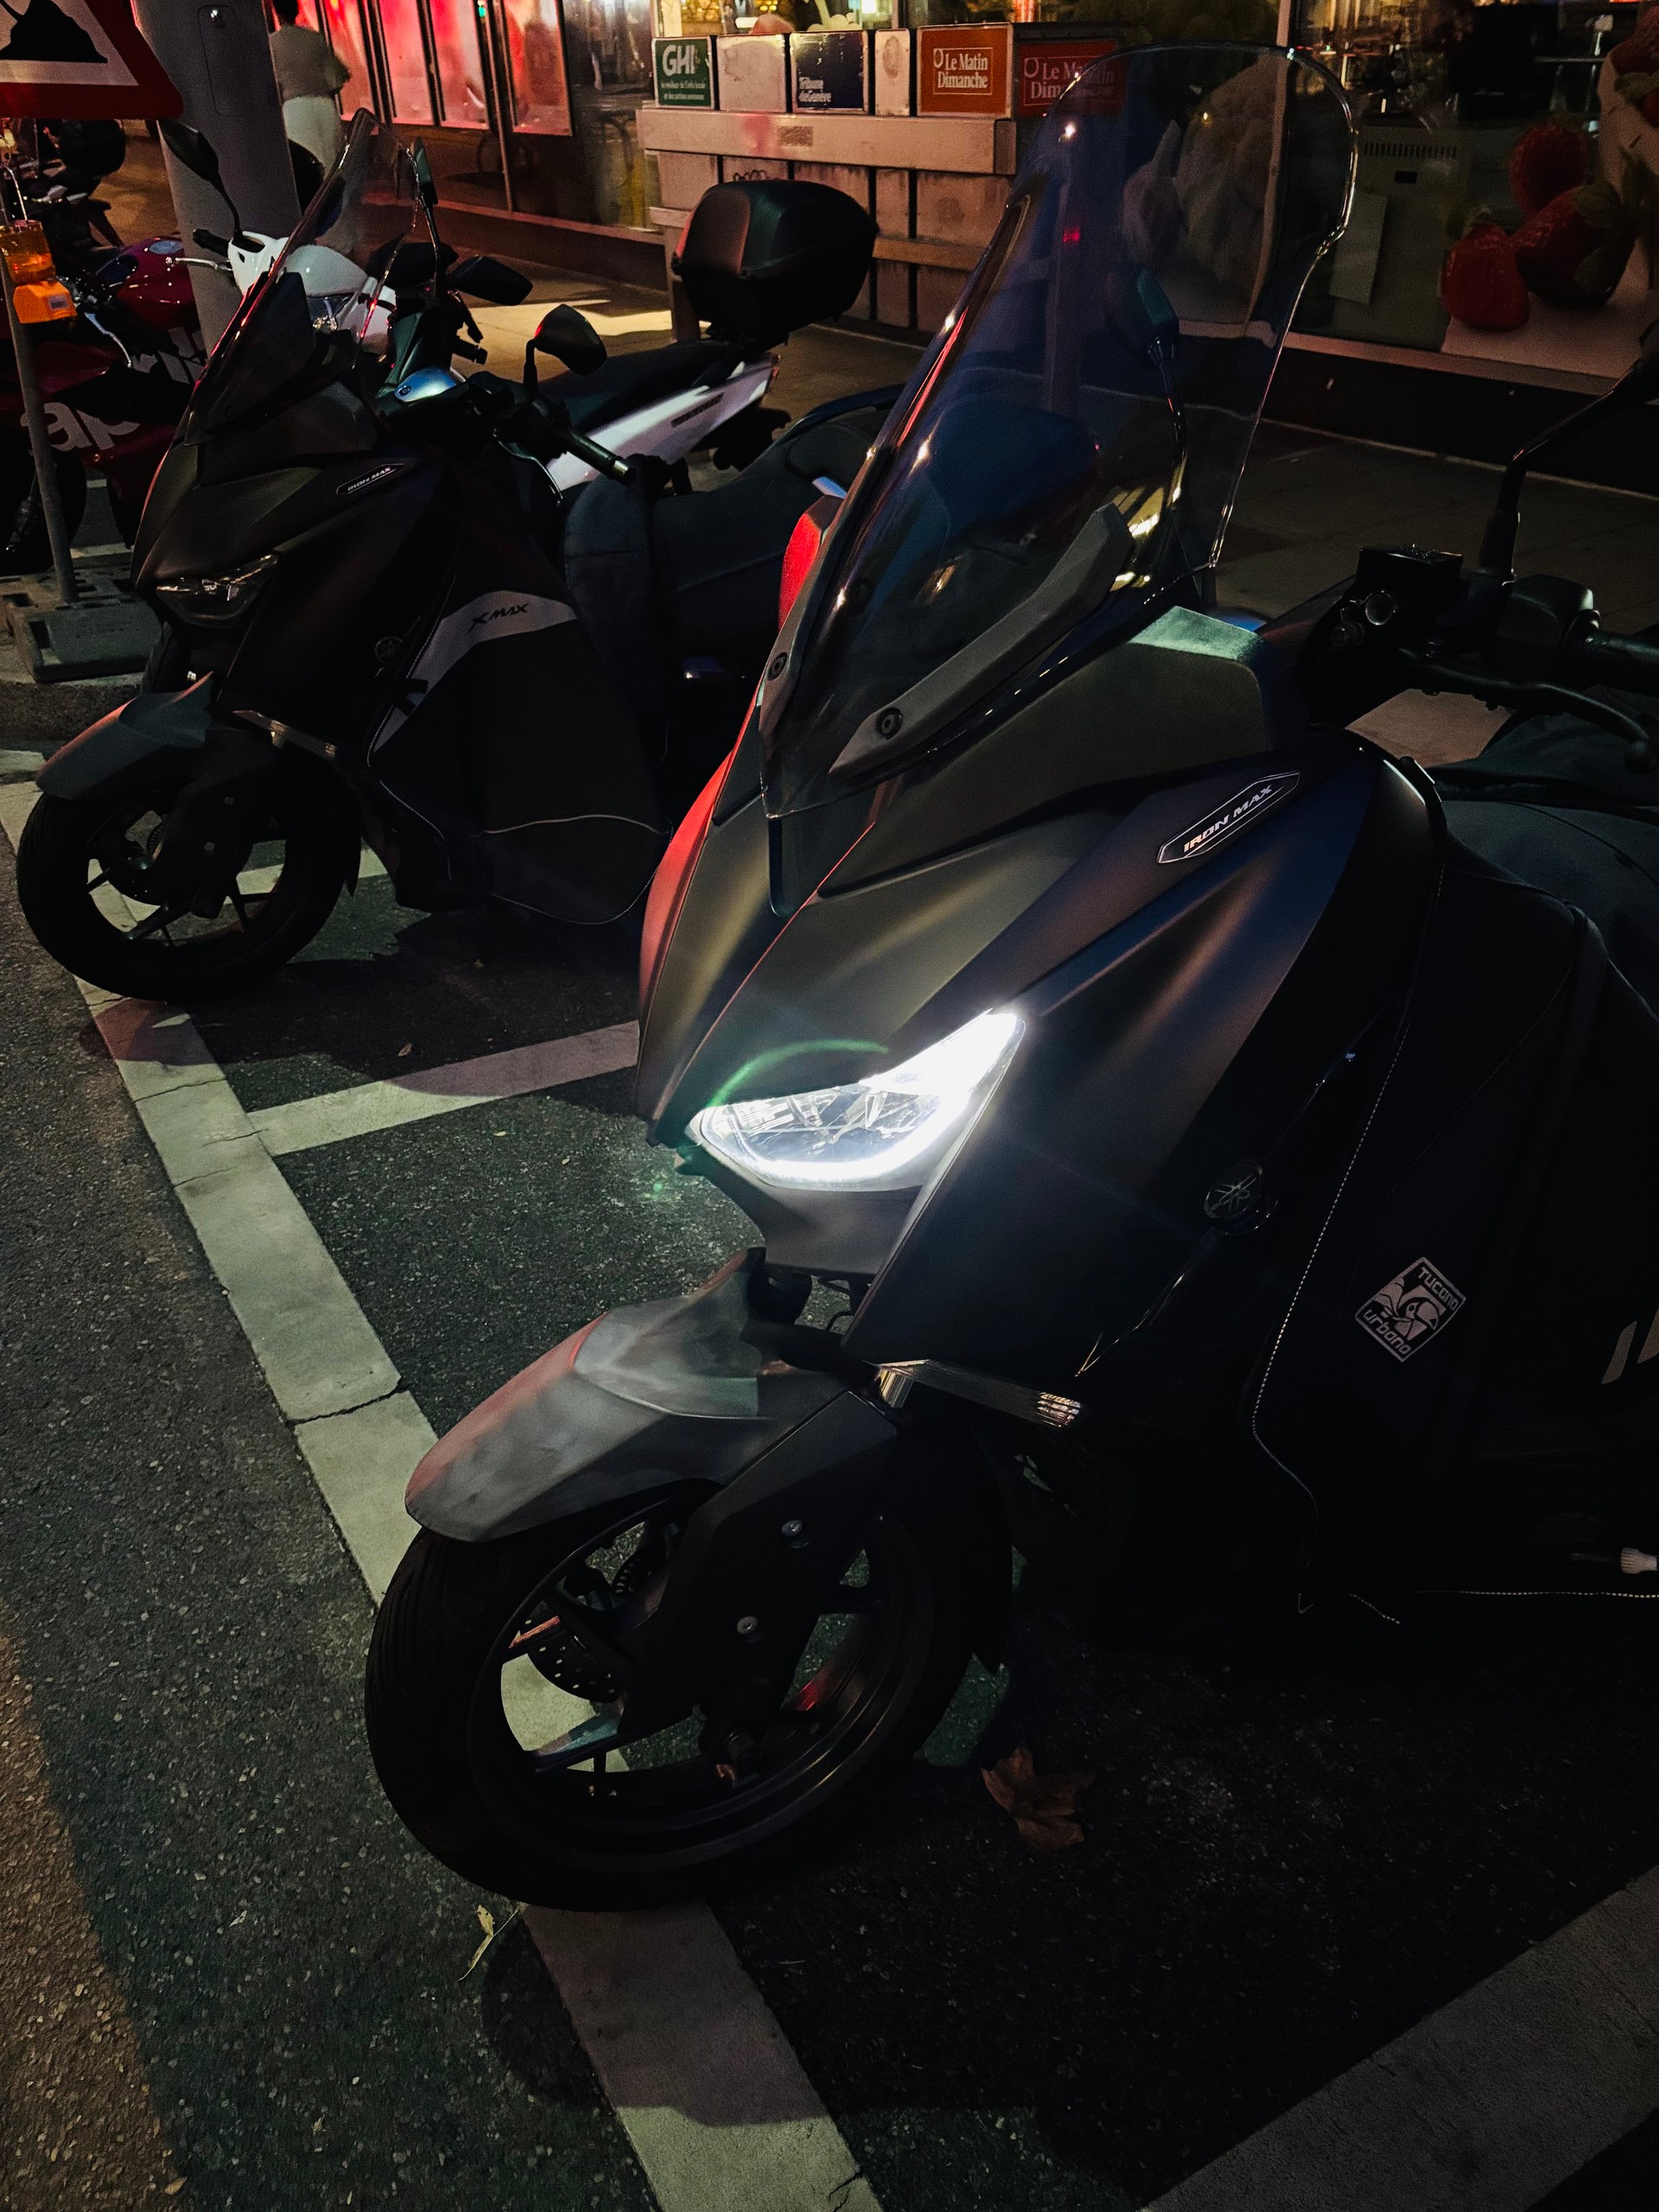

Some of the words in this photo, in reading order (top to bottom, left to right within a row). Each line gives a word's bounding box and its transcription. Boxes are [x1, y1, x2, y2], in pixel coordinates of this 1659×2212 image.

[945, 54, 957, 71] Le
[959, 52, 989, 72] Matin
[1042, 62, 1060, 80] Le
[938, 71, 989, 89] Dimanche
[1183, 815, 1230, 854] IRON
[1233, 784, 1273, 818] MAX
